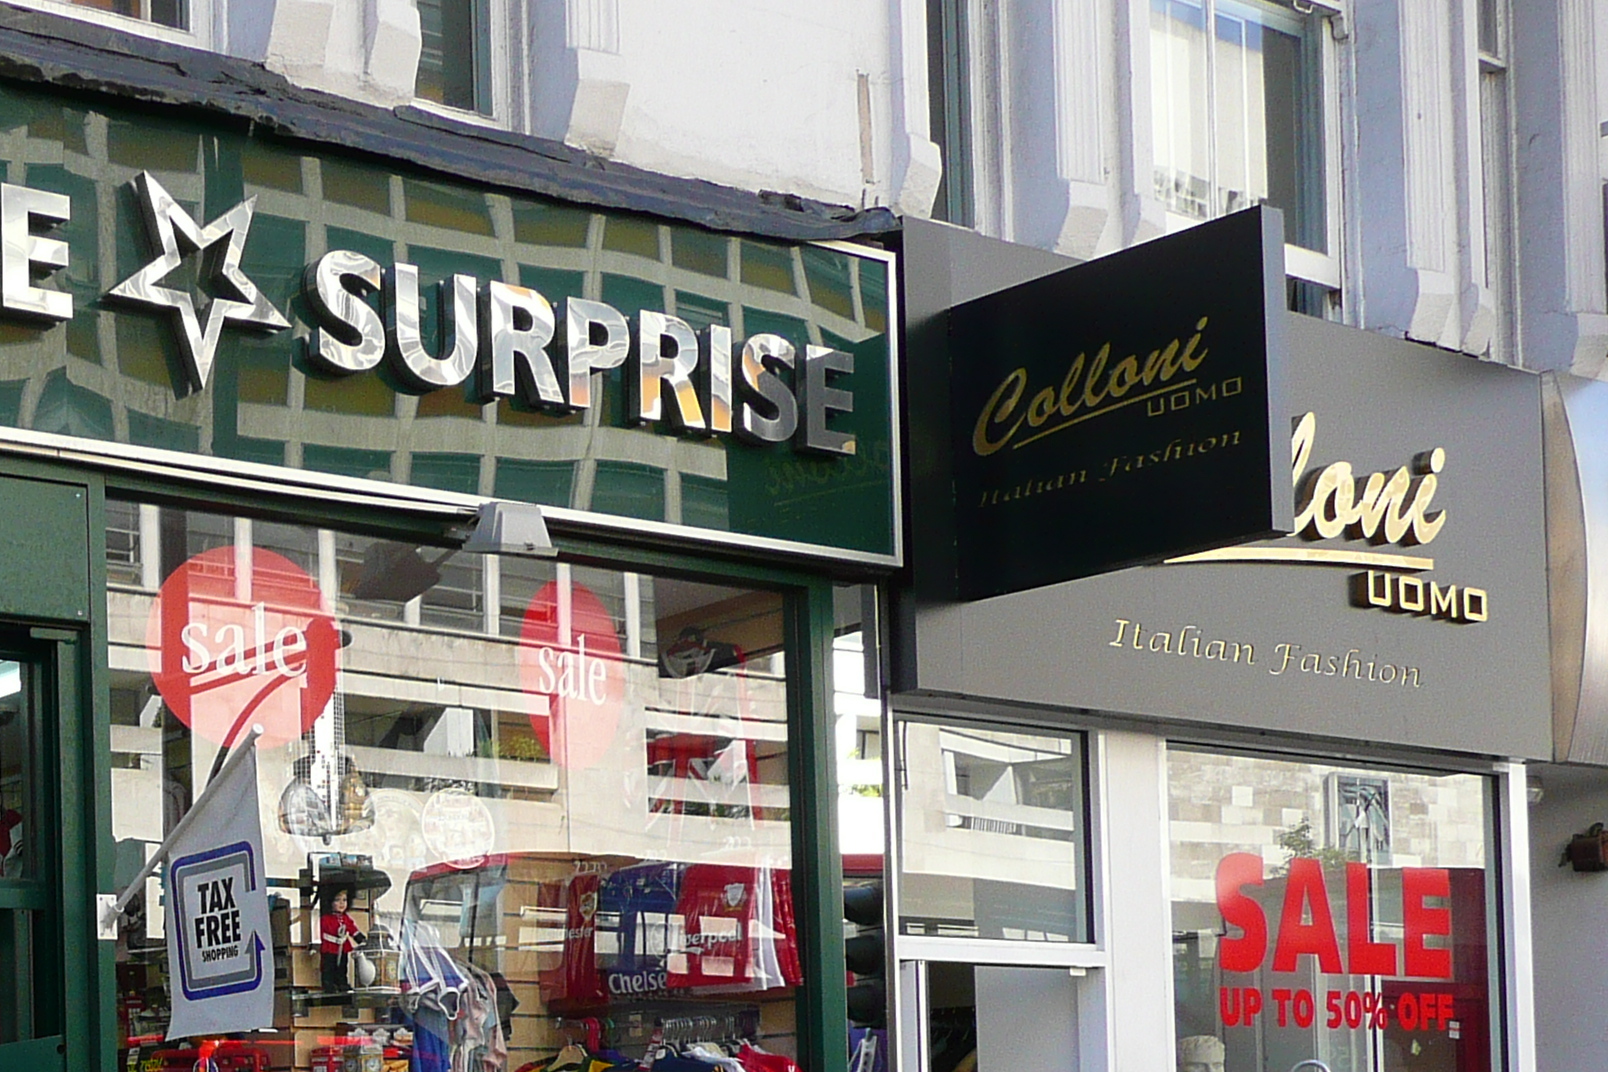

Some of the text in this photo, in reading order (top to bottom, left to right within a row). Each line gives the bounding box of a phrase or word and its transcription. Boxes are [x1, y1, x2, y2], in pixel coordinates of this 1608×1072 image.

[304, 249, 856, 456] SURPRISE
[972, 316, 1209, 457] Colloni
[1147, 376, 1243, 417] UOMO
[980, 428, 1242, 508] Italian Fashion
[1293, 411, 1447, 545] loni
[1368, 570, 1488, 623] UOMO
[181, 602, 307, 677] sale
[538, 633, 607, 706] sale
[1109, 618, 1423, 689] Italian Fashion
[194, 909, 242, 949] FREE
[197, 876, 236, 914] TAX
[1216, 851, 1453, 978] SALE
[202, 945, 239, 963] SHOPPING
[608, 970, 667, 995] Chelse
[1220, 987, 1454, 1032] UP TO 50% OFF
